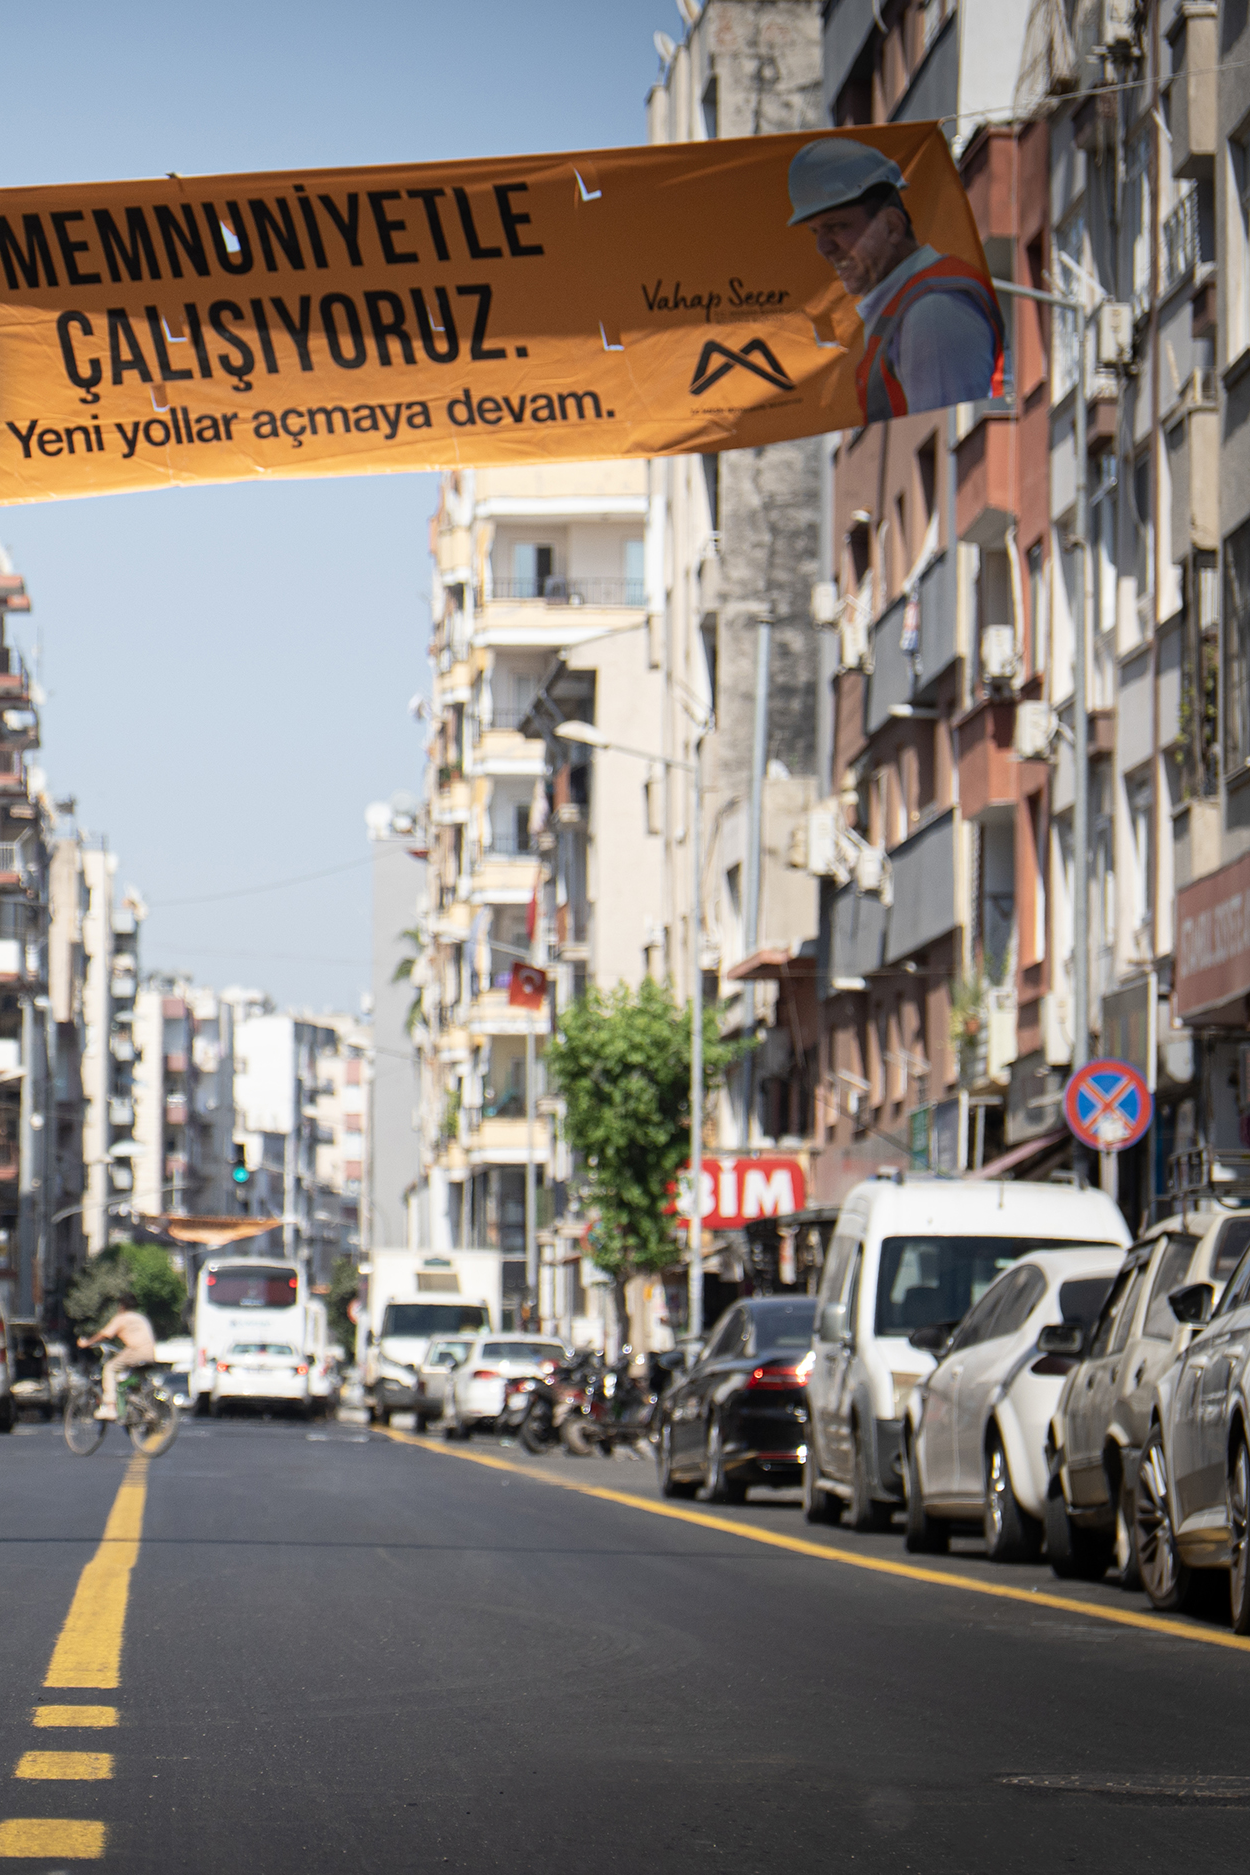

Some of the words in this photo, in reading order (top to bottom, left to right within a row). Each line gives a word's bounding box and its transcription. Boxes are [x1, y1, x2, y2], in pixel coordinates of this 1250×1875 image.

[641, 278, 721, 323] Vahap
[56, 283, 529, 405] ÇALIŞIYORUZ.
[5, 414, 105, 459] Yeni
[114, 405, 238, 459] yollar
[252, 401, 432, 448] açmaya
[447, 387, 616, 428] devam.
